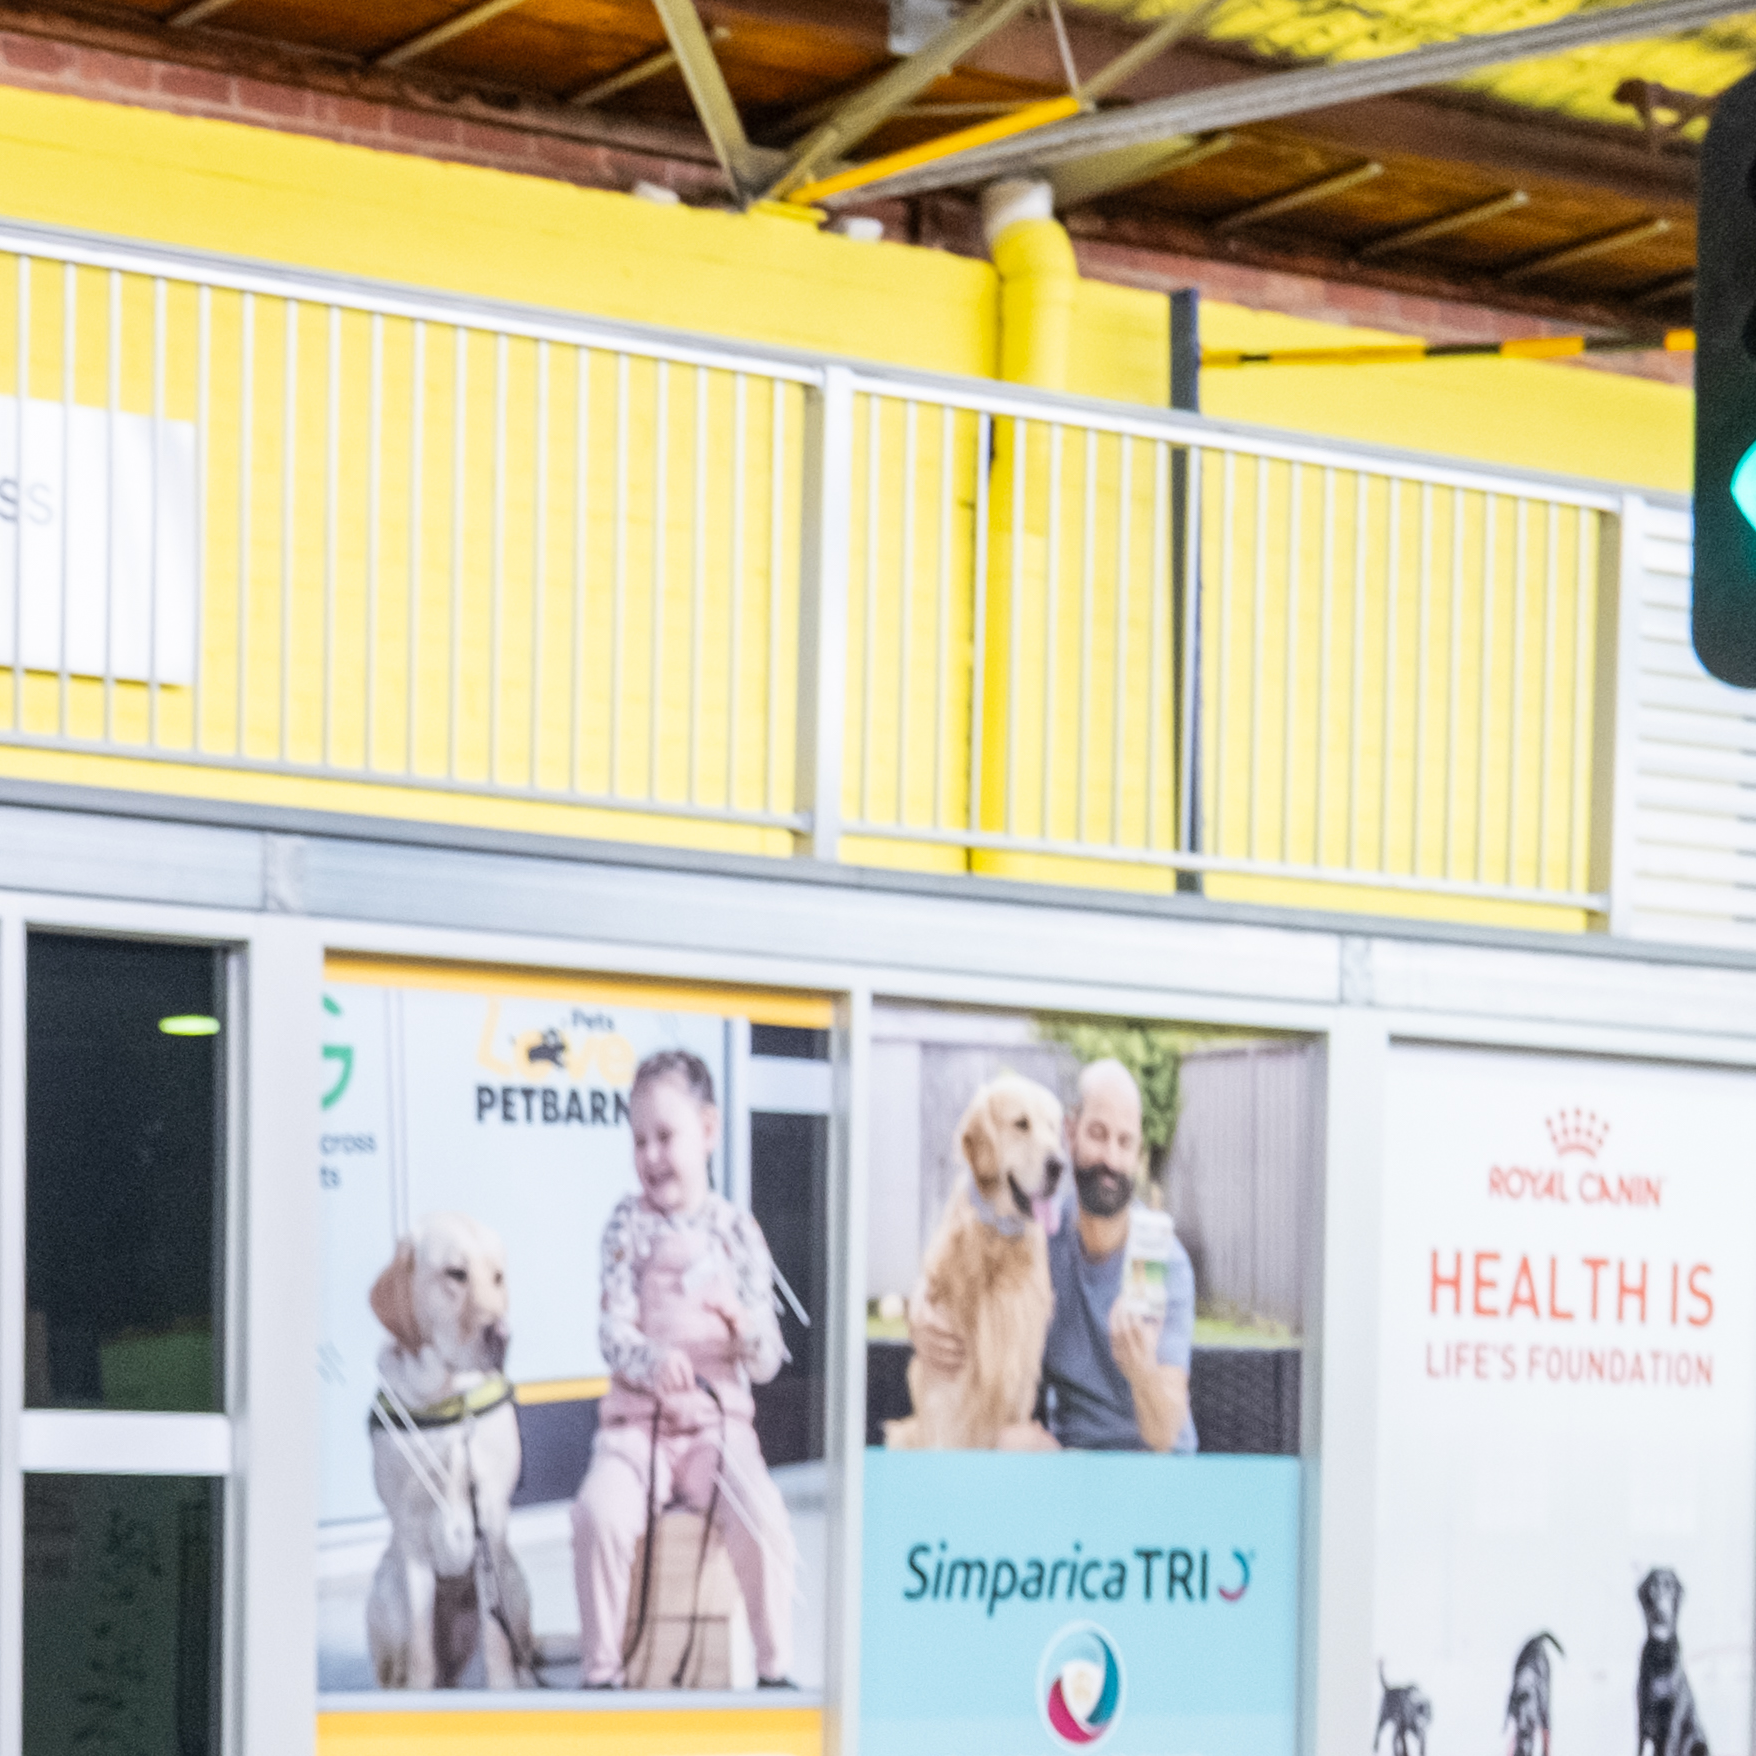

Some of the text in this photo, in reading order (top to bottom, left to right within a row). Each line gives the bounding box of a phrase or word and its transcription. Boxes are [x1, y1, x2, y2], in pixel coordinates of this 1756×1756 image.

[476, 1085, 631, 1125] PETBARN
[1488, 1164, 1662, 1207] ROYAL CANIN
[1430, 1250, 1714, 1327] HEALTH IS
[1426, 1342, 1713, 1386] LIFE'S FOUNDATION
[904, 1541, 1127, 1618] Simparica
